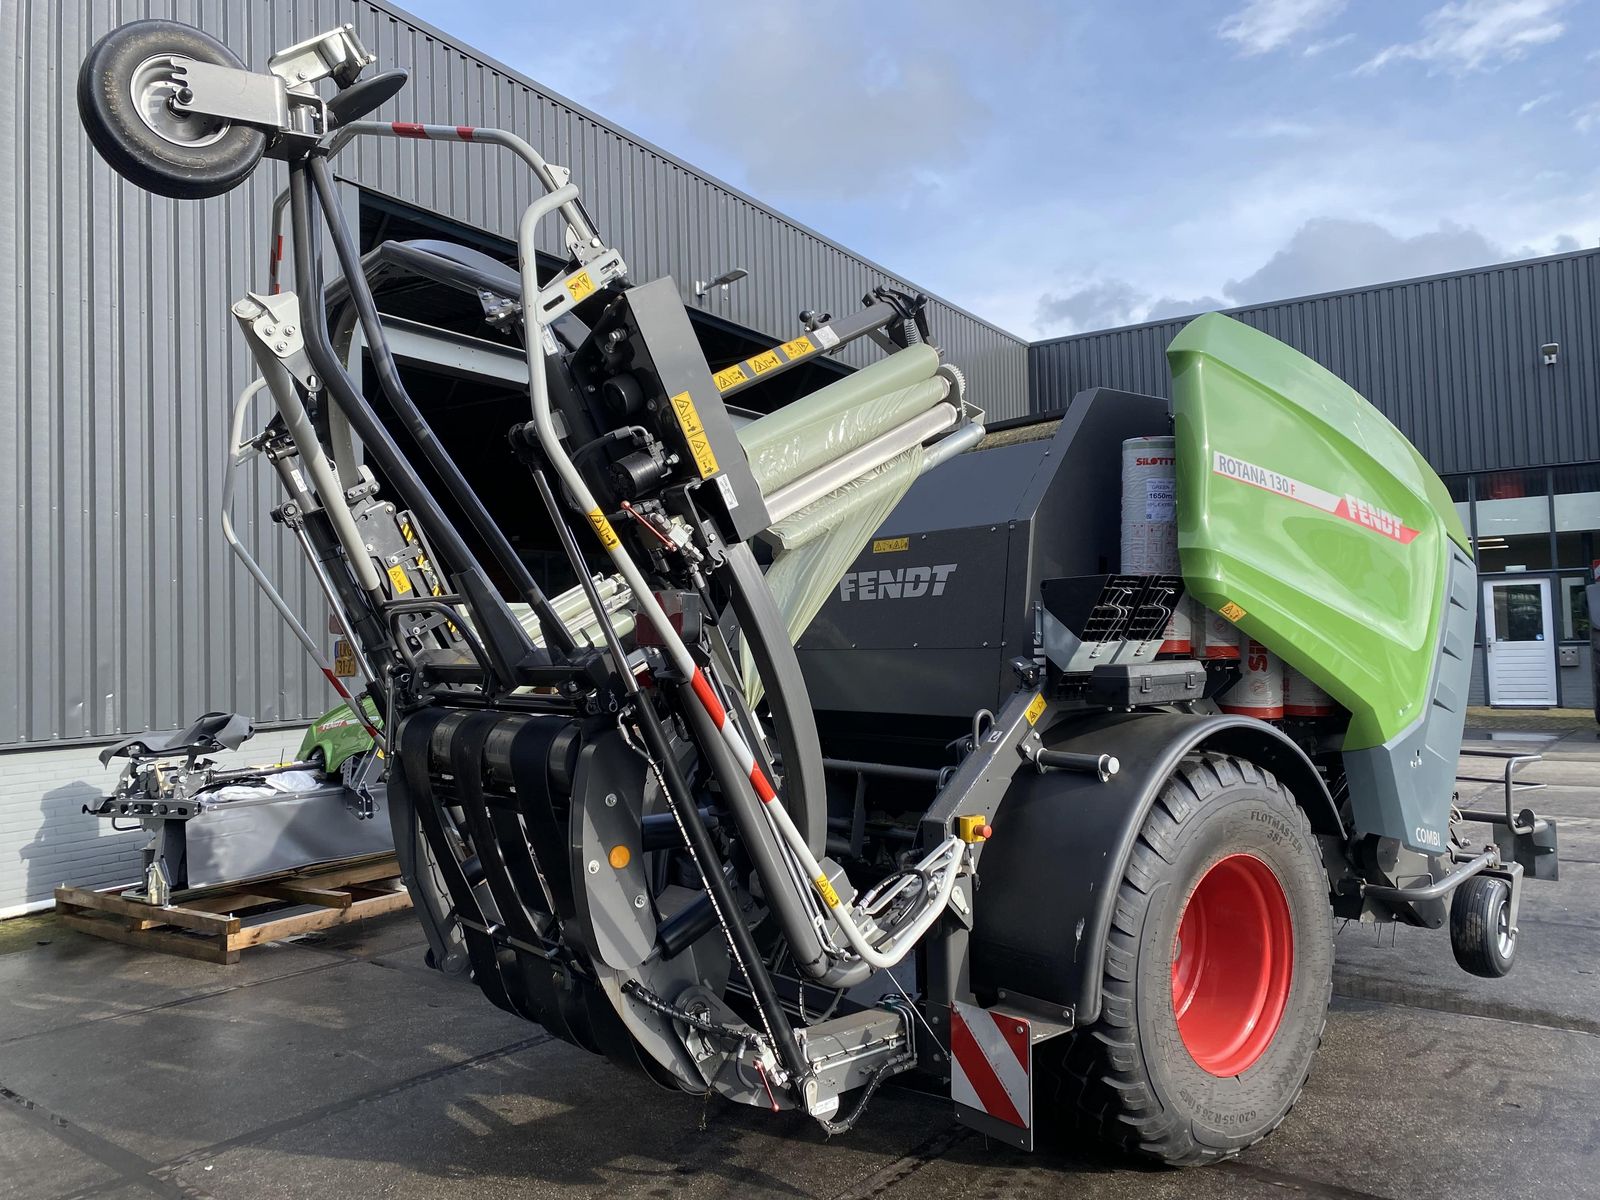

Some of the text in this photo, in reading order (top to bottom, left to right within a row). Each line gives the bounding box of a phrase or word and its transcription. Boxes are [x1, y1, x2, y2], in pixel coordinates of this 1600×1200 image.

[1219, 455, 1267, 486] ROTANA
[1269, 473, 1289, 494] 130
[1344, 494, 1403, 539] FENDT
[840, 563, 958, 602] FENDT
[1250, 811, 1303, 854] FLOTMASTER
[1415, 827, 1441, 847] COMBI
